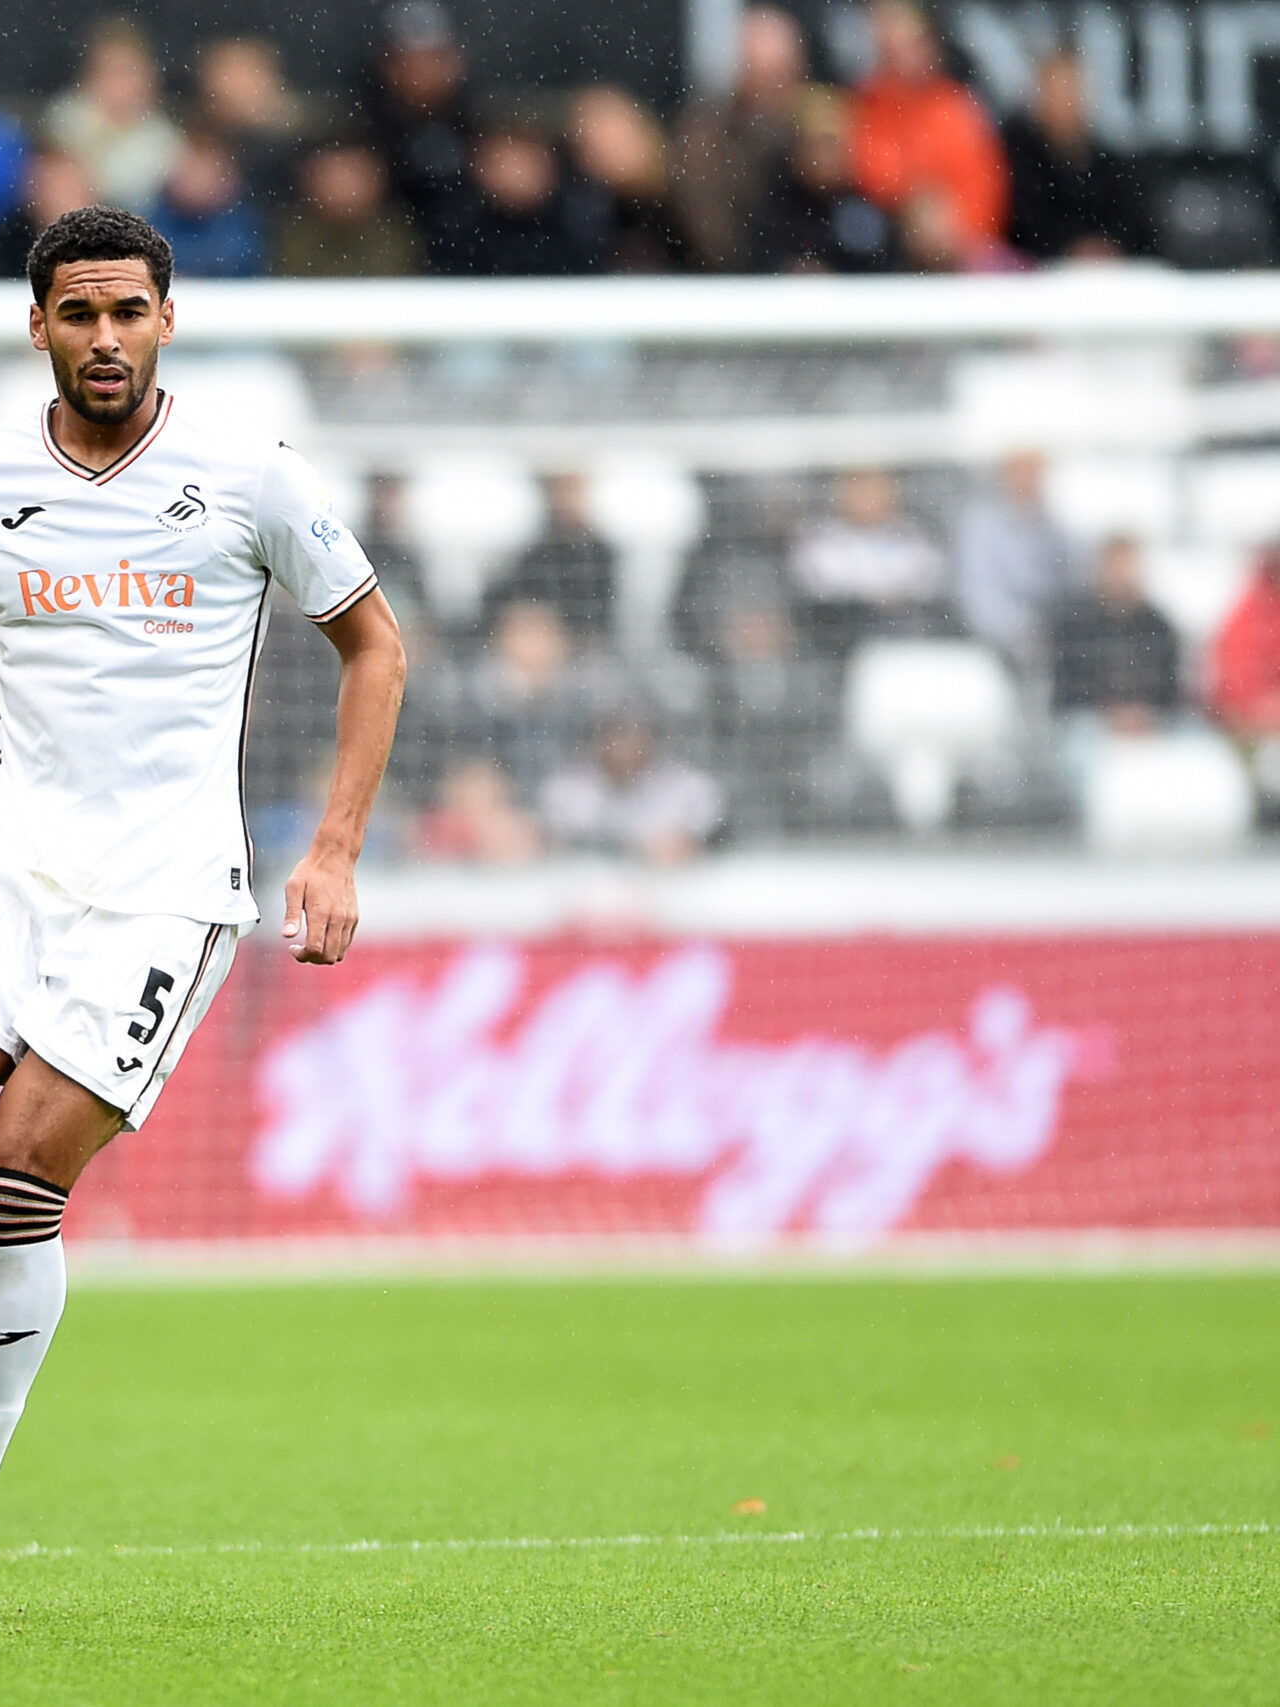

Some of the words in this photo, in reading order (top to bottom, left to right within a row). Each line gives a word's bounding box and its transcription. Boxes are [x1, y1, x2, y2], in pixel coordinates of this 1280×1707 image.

[18, 559, 195, 617] Reviva
[144, 619, 194, 634] Coffee
[127, 966, 175, 1045] 5
